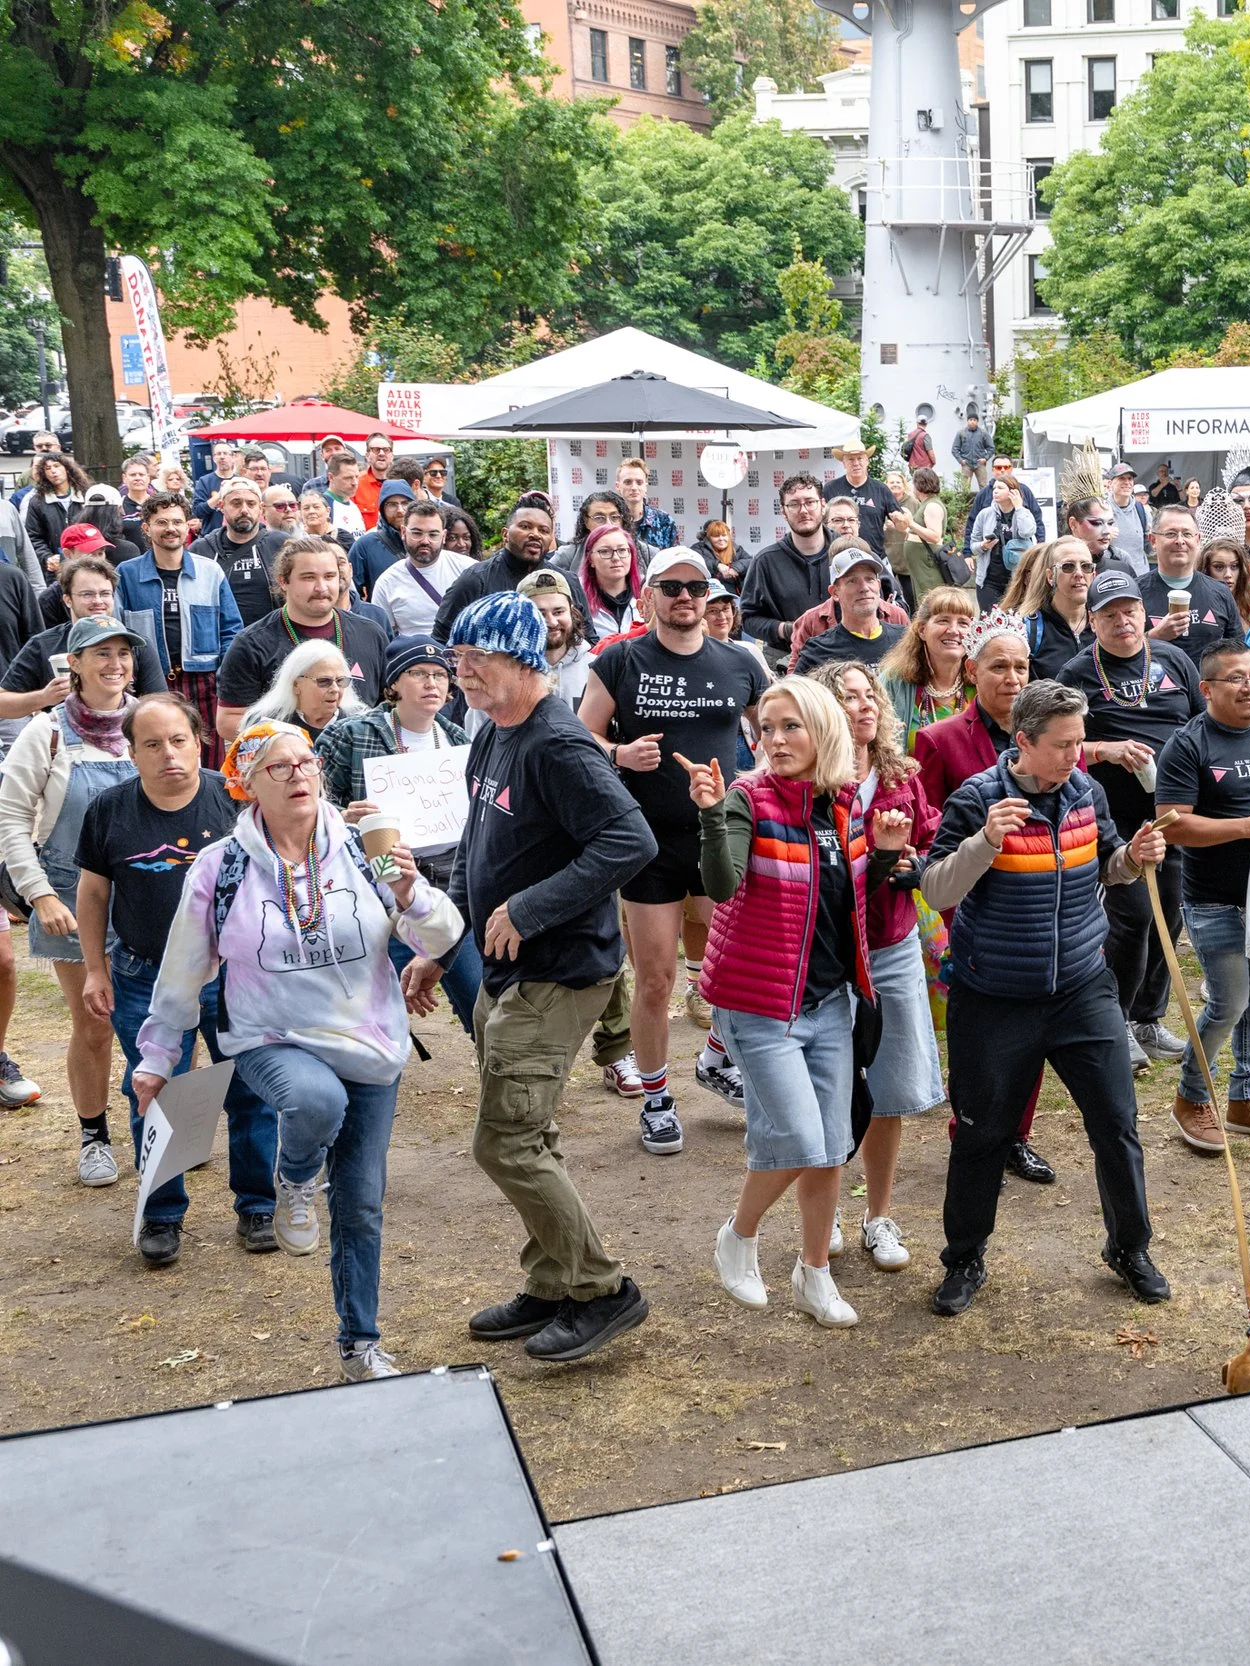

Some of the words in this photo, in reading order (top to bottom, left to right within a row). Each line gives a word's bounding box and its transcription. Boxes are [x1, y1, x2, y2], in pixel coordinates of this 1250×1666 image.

[128, 273, 154, 366] DONATE
[387, 390, 421, 399] AIDS
[387, 400, 421, 409] WALK
[386, 410, 422, 418] NORTH
[388, 419, 422, 428] WEST
[640, 673, 673, 685] PrEP
[678, 677, 687, 686] &
[638, 684, 671, 696] U=U
[676, 688, 685, 696] &
[636, 695, 723, 709] Doxycycline
[727, 697, 736, 706] &
[634, 706, 700, 718] Jynneos.
[370, 764, 436, 794] Stigma
[438, 760, 466, 784] Su
[420, 791, 454, 810] but
[413, 811, 468, 836] Swallo
